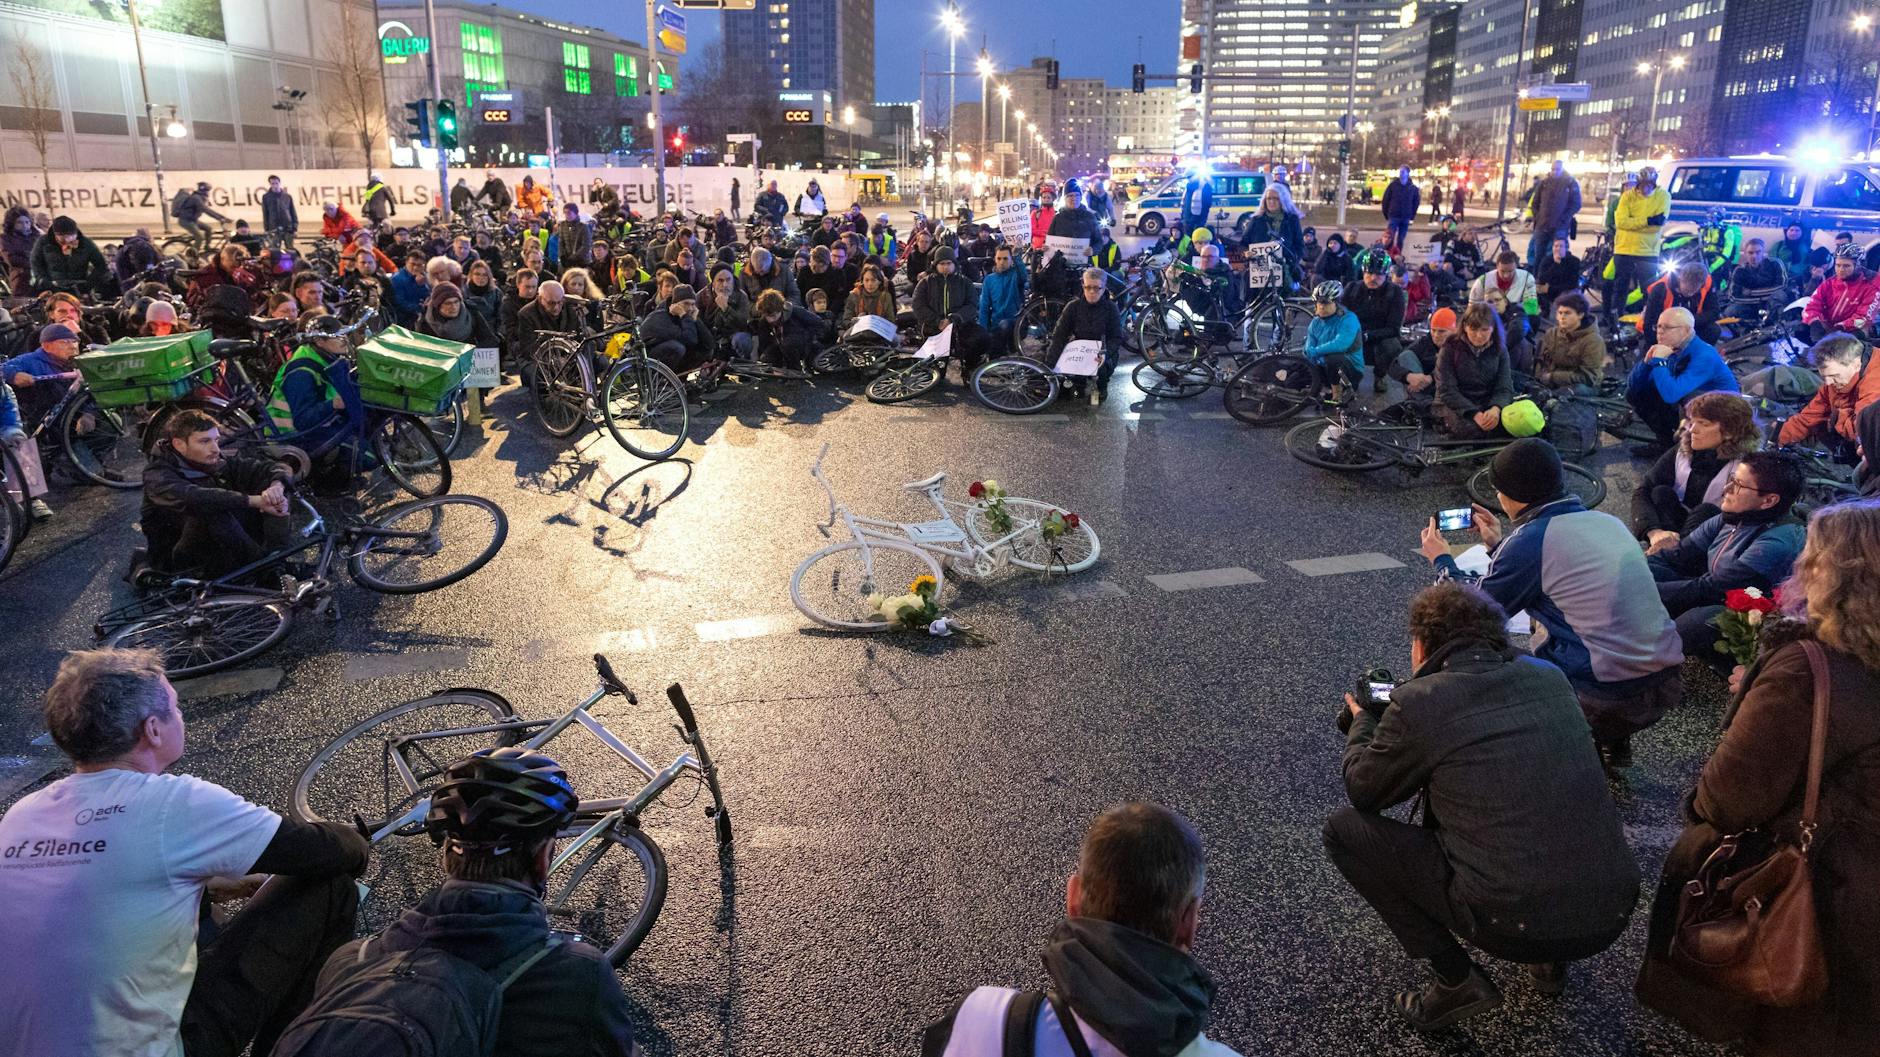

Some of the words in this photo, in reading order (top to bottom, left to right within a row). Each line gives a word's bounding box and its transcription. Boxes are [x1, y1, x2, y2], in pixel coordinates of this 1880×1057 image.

[484, 110, 508, 121] CCC
[785, 110, 810, 121] CCC
[999, 202, 1027, 214] STOP
[1001, 215, 1029, 224] KILLING
[1731, 213, 1783, 227] POLIZEI
[1002, 223, 1030, 232] CYCLISTS
[1005, 232, 1030, 242] STOP
[1251, 275, 1281, 284] STP
[1080, 345, 1099, 354] Zero
[96, 804, 126, 816] adfc
[4, 840, 30, 858] of
[30, 839, 107, 858] Silence
